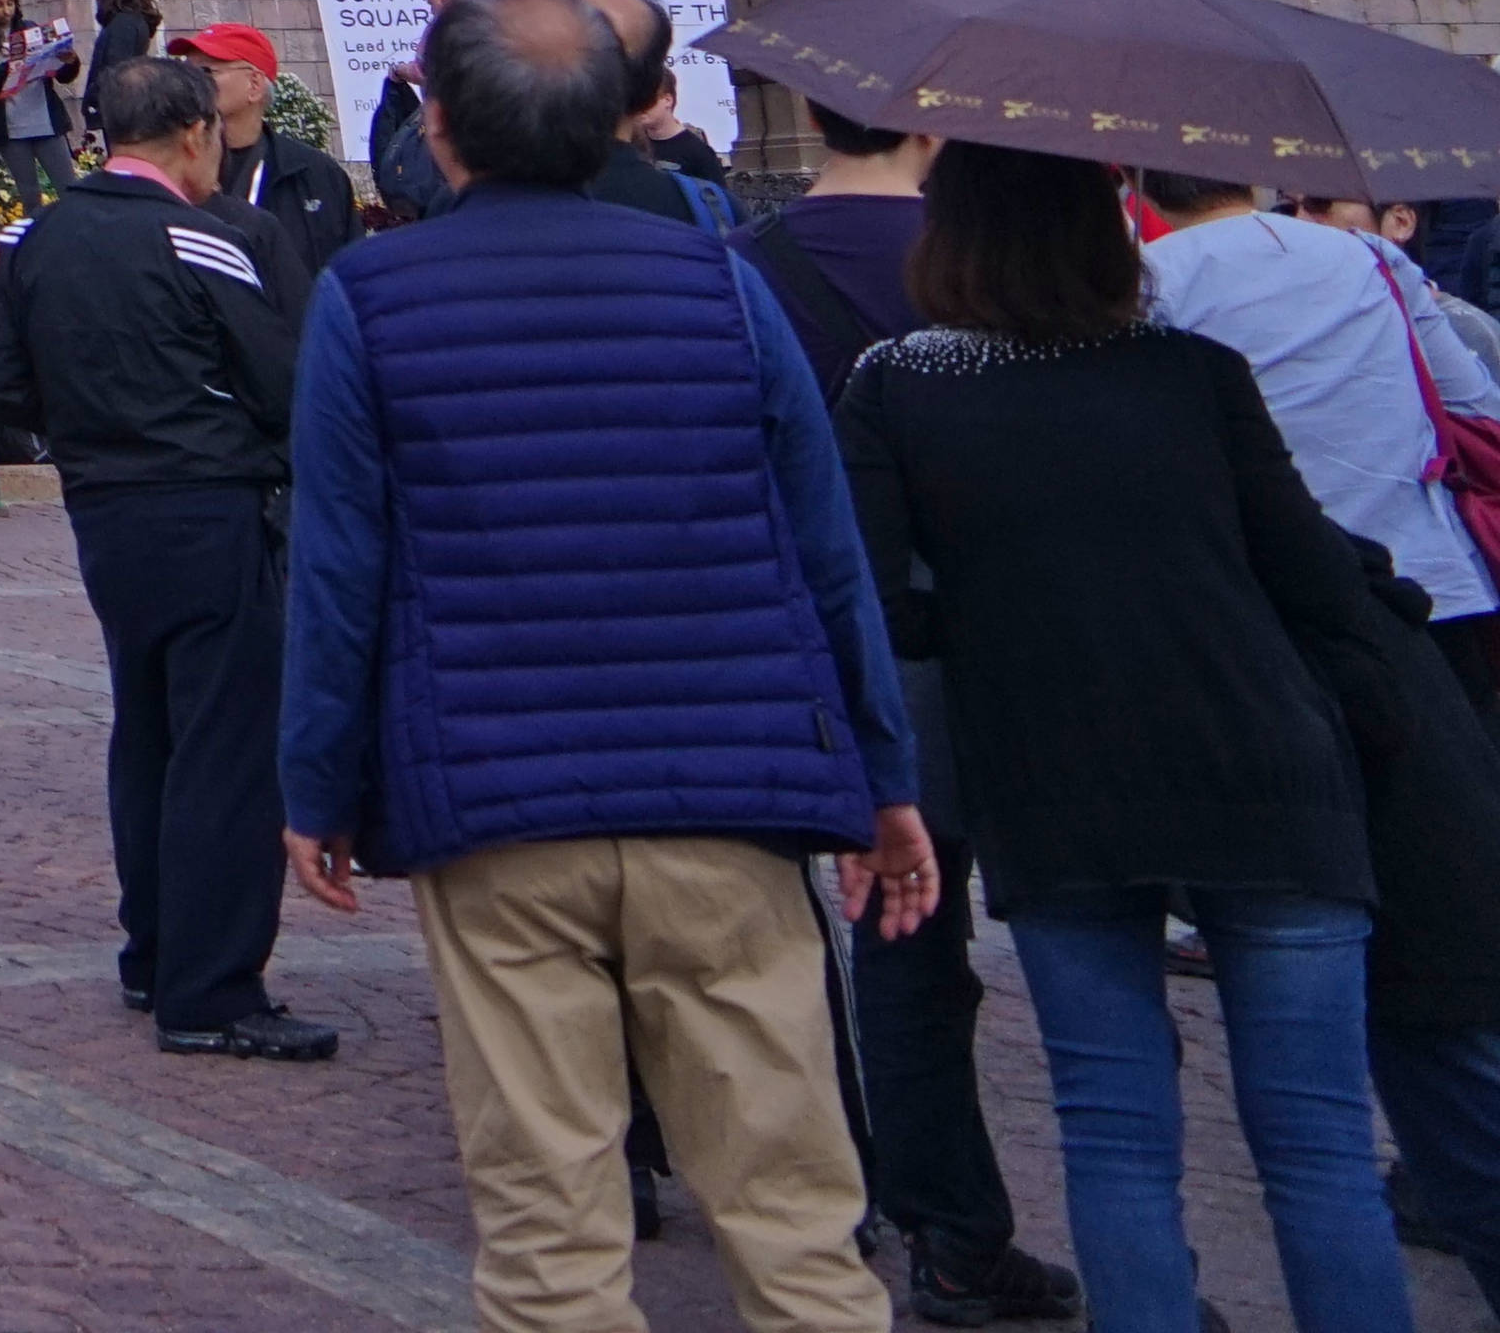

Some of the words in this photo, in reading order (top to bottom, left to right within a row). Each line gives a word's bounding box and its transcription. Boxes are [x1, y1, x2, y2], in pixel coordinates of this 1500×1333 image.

[340, 9, 430, 28] SQUAR
[691, 5, 728, 22] TH
[344, 39, 385, 52] Lead
[392, 39, 418, 52] the
[348, 58, 407, 71] Open
